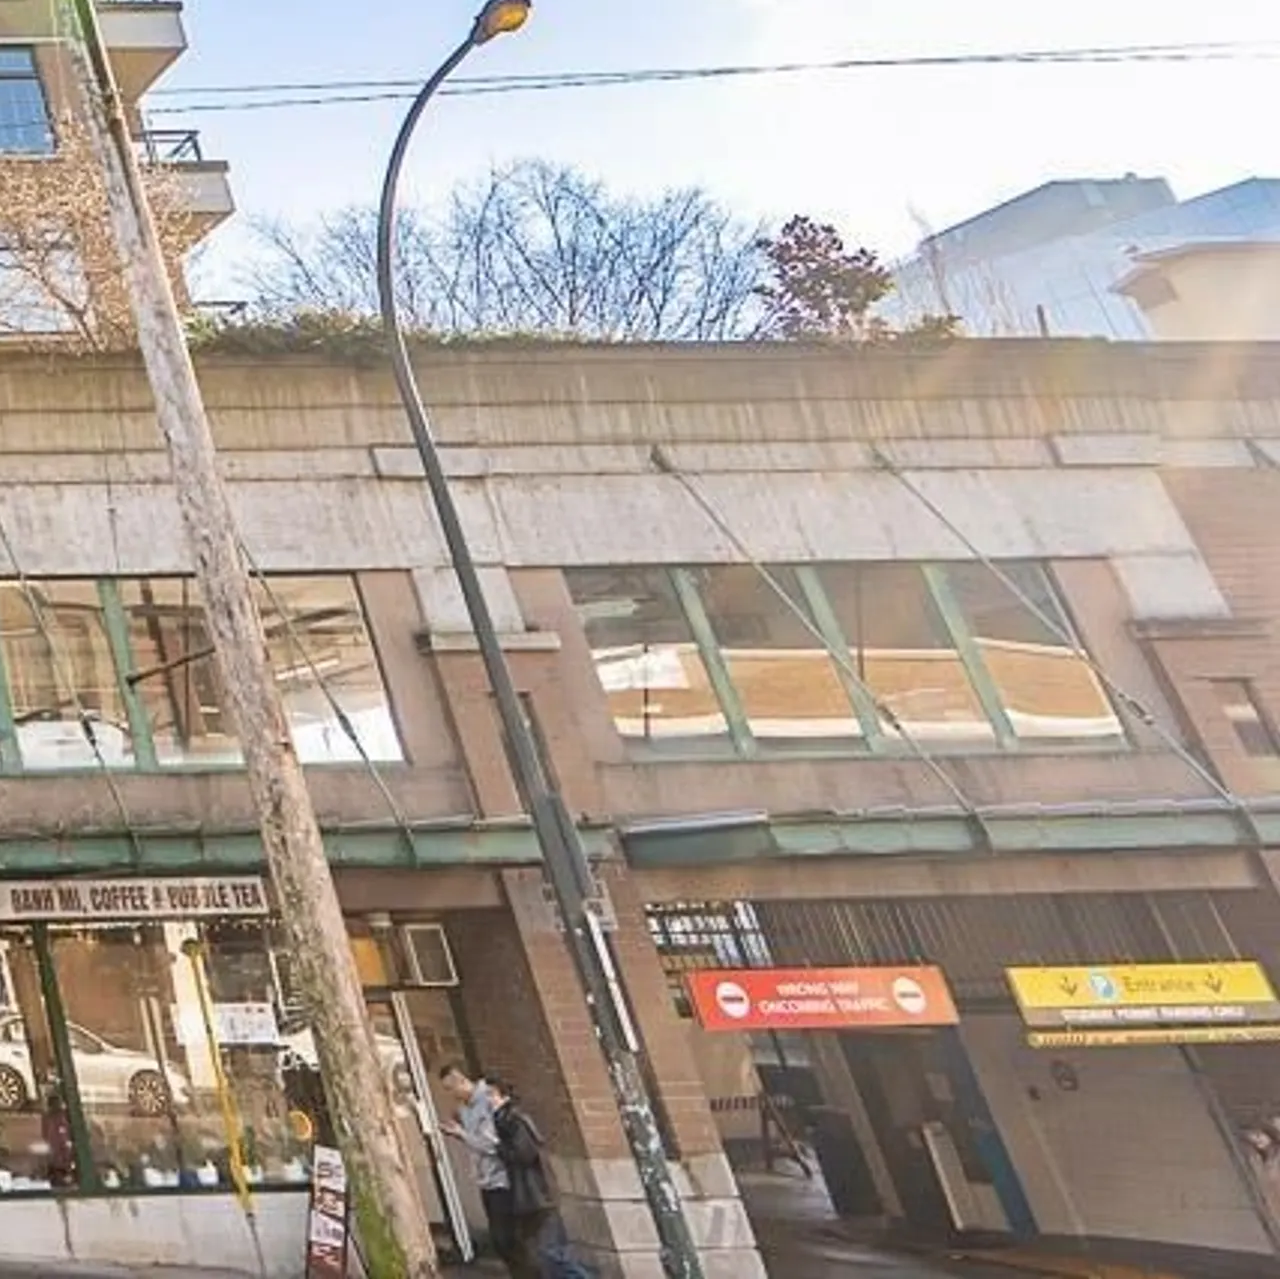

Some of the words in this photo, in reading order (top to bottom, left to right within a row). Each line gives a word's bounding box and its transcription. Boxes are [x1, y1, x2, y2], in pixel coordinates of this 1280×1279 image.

[90, 885, 150, 911] COFFEE
[231, 882, 264, 907] TEA
[1121, 975, 1197, 994] Entrance
